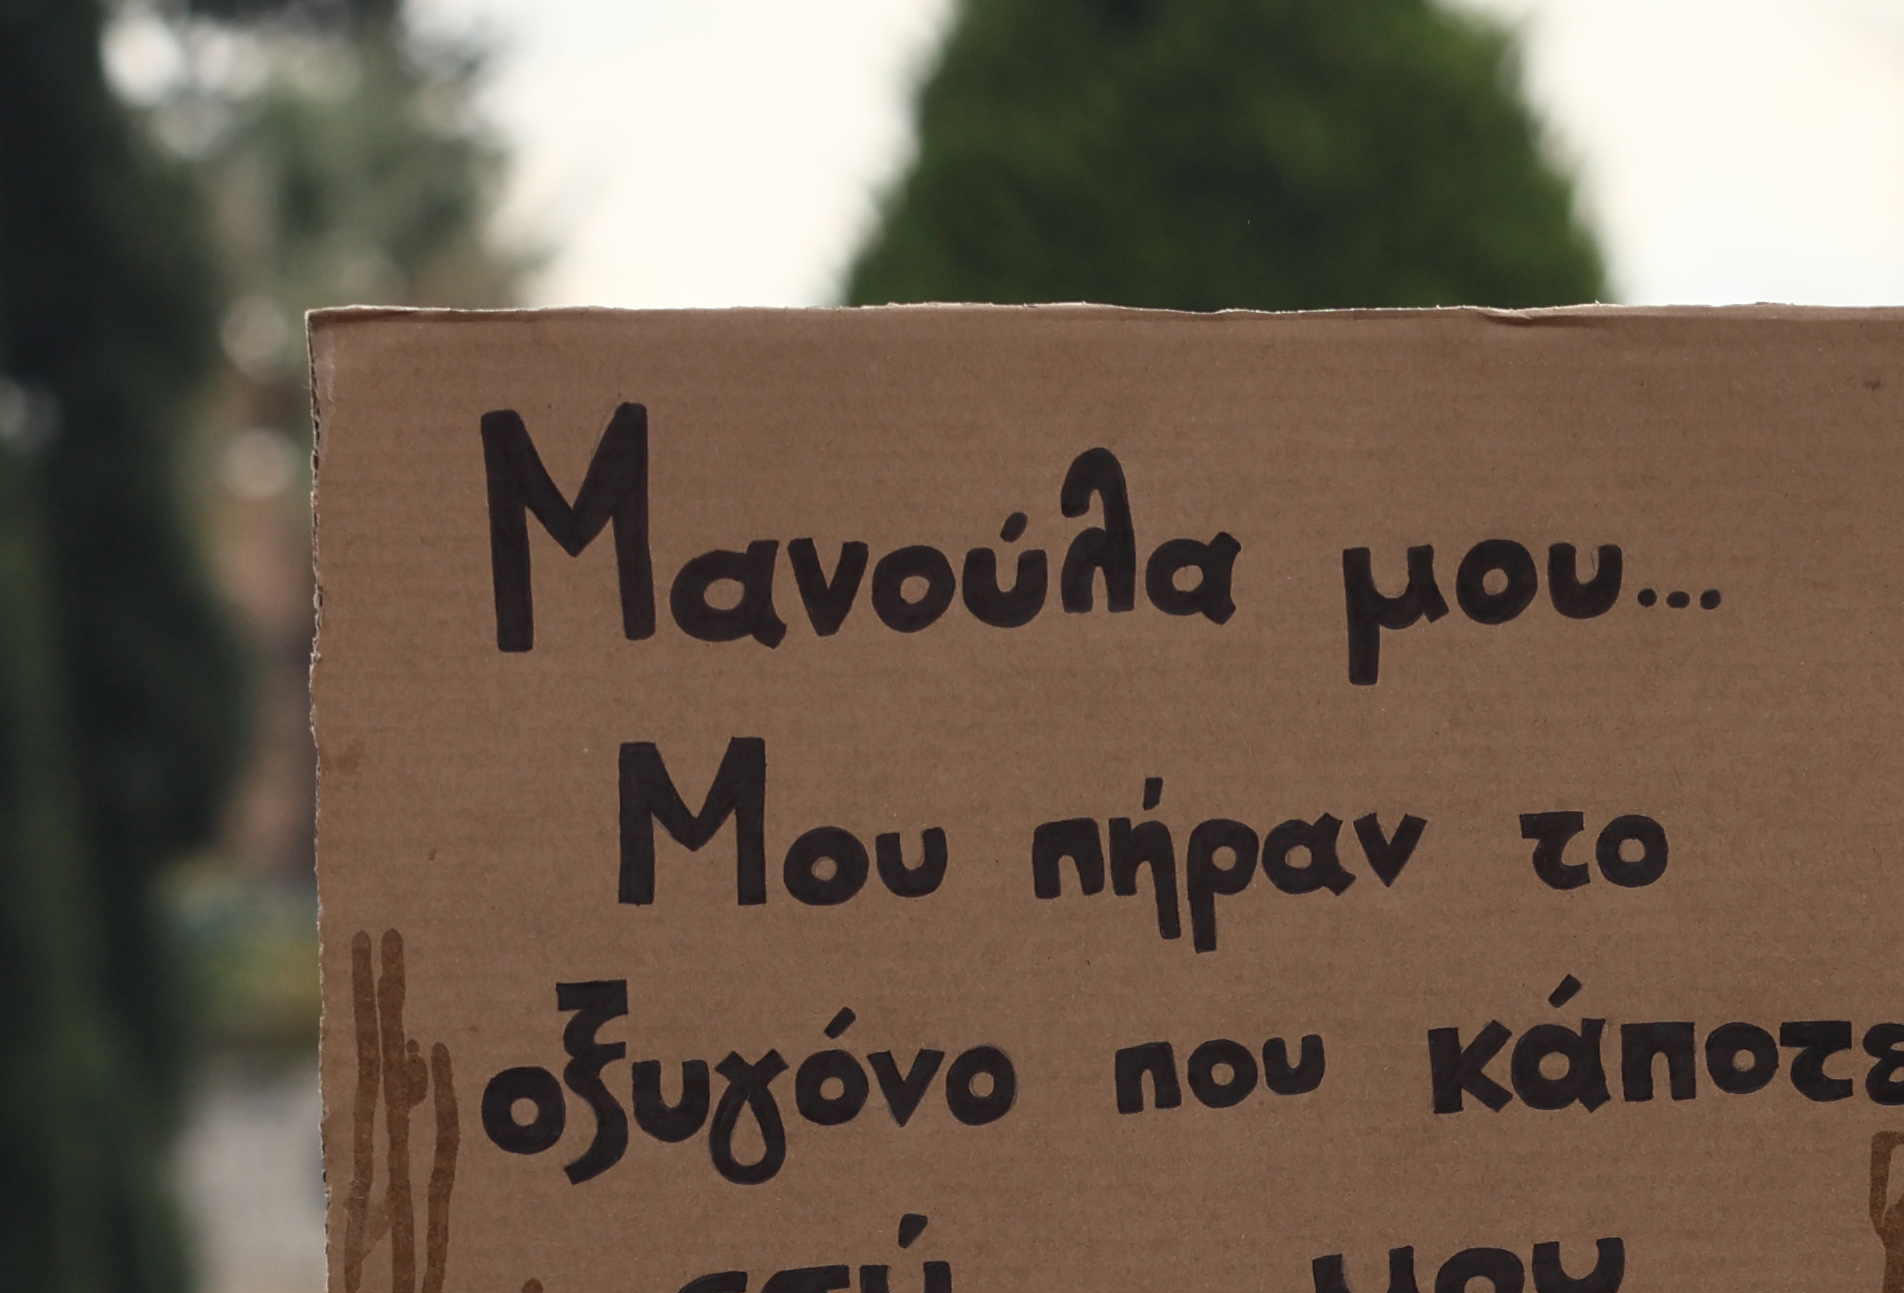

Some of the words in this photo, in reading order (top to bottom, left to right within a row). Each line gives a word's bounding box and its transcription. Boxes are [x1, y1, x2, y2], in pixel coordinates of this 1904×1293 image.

[479, 400, 1243, 654] Μανούλα
[1341, 537, 1722, 687] μου...
[617, 735, 949, 908] Μου
[1030, 776, 1429, 955] πήραν
[1517, 809, 1670, 892] το
[480, 978, 1018, 1186] οξυγόνο
[1113, 1033, 1327, 1116] που
